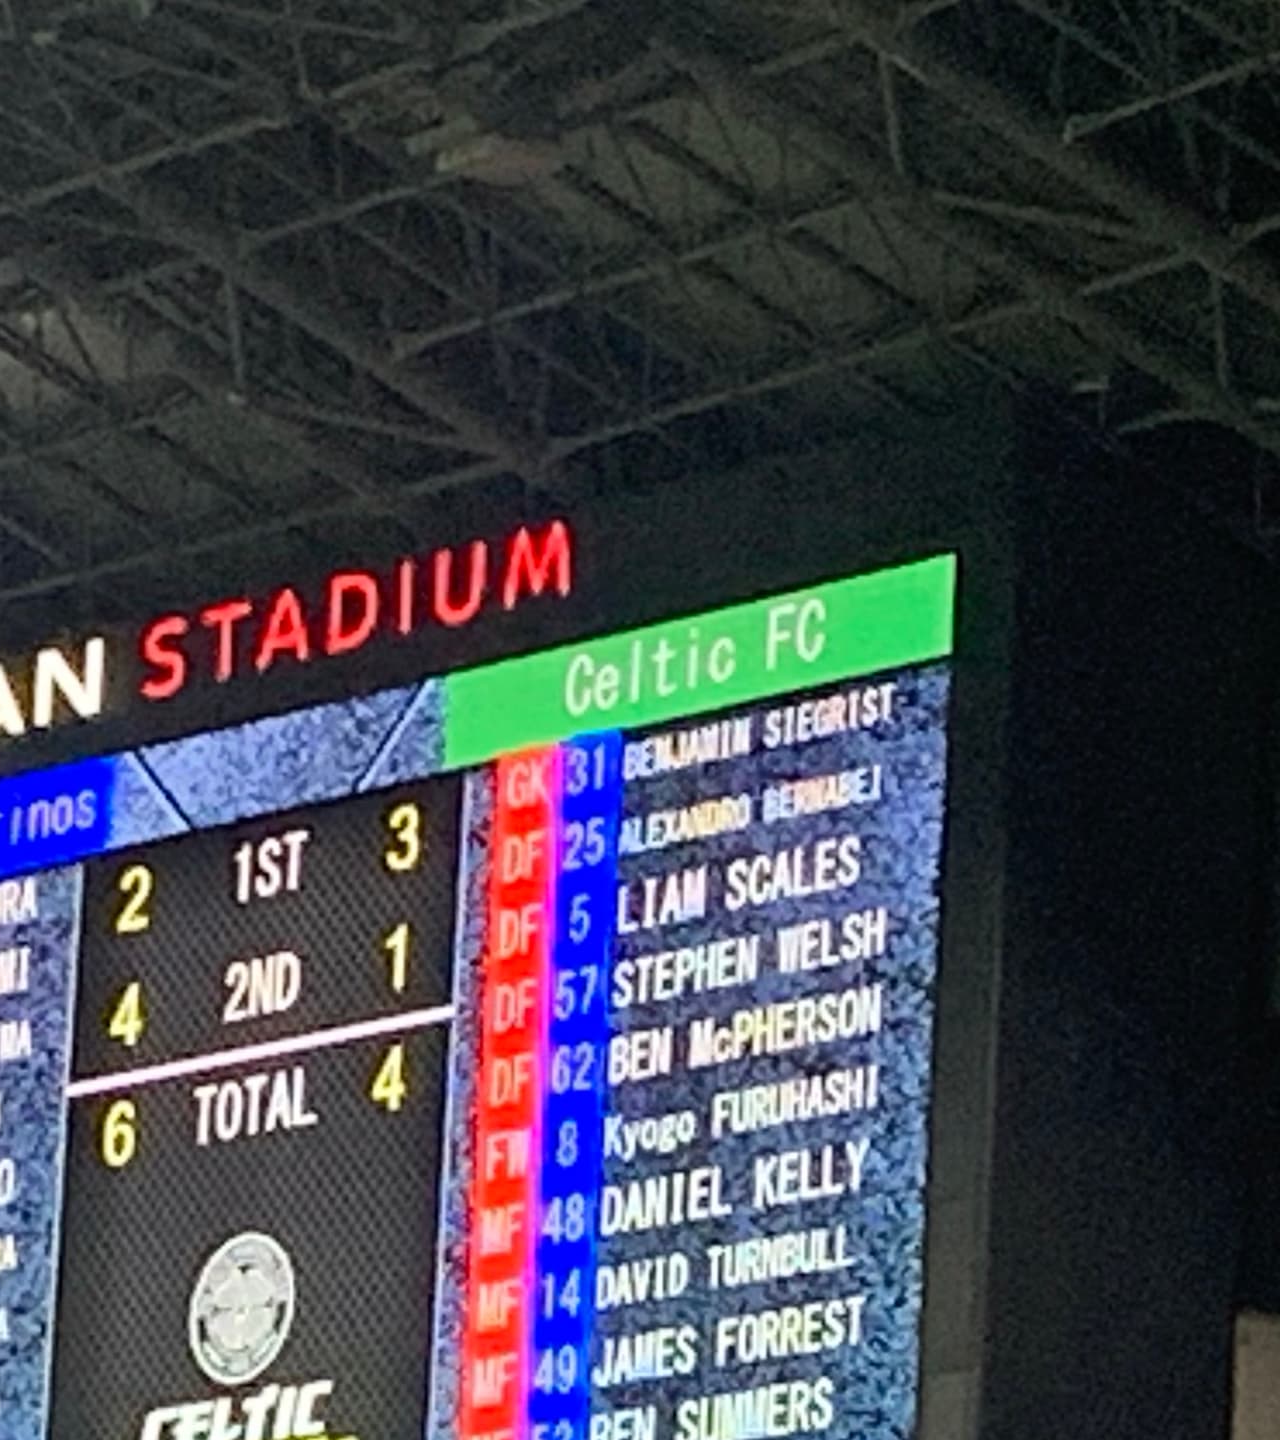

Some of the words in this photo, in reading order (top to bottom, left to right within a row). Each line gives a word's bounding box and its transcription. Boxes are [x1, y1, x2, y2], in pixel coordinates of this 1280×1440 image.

[139, 519, 573, 700] STADIUM
[564, 628, 736, 716] Celtic
[764, 597, 827, 673] FC
[506, 761, 548, 810] GK
[565, 746, 605, 795] 31
[622, 717, 751, 781] BENJAMIN
[763, 682, 897, 749] SIEGRIST
[116, 865, 153, 933] 2
[234, 829, 309, 903] 1ST
[385, 803, 421, 871] 3
[496, 904, 543, 960] DF
[568, 894, 592, 943] 5
[617, 864, 709, 934] LIAM
[724, 835, 862, 910] SCALES
[502, 830, 546, 885] DF
[561, 817, 606, 870] 25
[108, 981, 144, 1047] 4
[222, 951, 301, 1025] 2ND
[385, 923, 409, 993] 1
[493, 979, 539, 1034] DF
[553, 964, 599, 1021] 57
[613, 935, 759, 1003] STEPHEN
[778, 908, 887, 970] WELSH
[102, 1100, 136, 1168] 6
[192, 1066, 318, 1146] TOTAL
[371, 1044, 407, 1112] 4
[489, 1051, 535, 1107] DF
[552, 1041, 596, 1094] 62
[607, 1026, 674, 1085] BEN
[687, 984, 882, 1070] McPHERSON
[556, 1121, 579, 1166] 8
[603, 1109, 697, 1160] Kyogo
[711, 1064, 879, 1140] FURUHASHI
[542, 1193, 585, 1244] 48
[600, 1166, 732, 1237] DANIEL
[753, 1139, 871, 1207] KELLY
[544, 1268, 581, 1320] 14
[595, 1253, 689, 1306] DAVID
[707, 1225, 856, 1289] TURNBULL
[534, 1345, 578, 1394] 49
[591, 1326, 698, 1388] JAMES
[715, 1297, 865, 1368] FORREST
